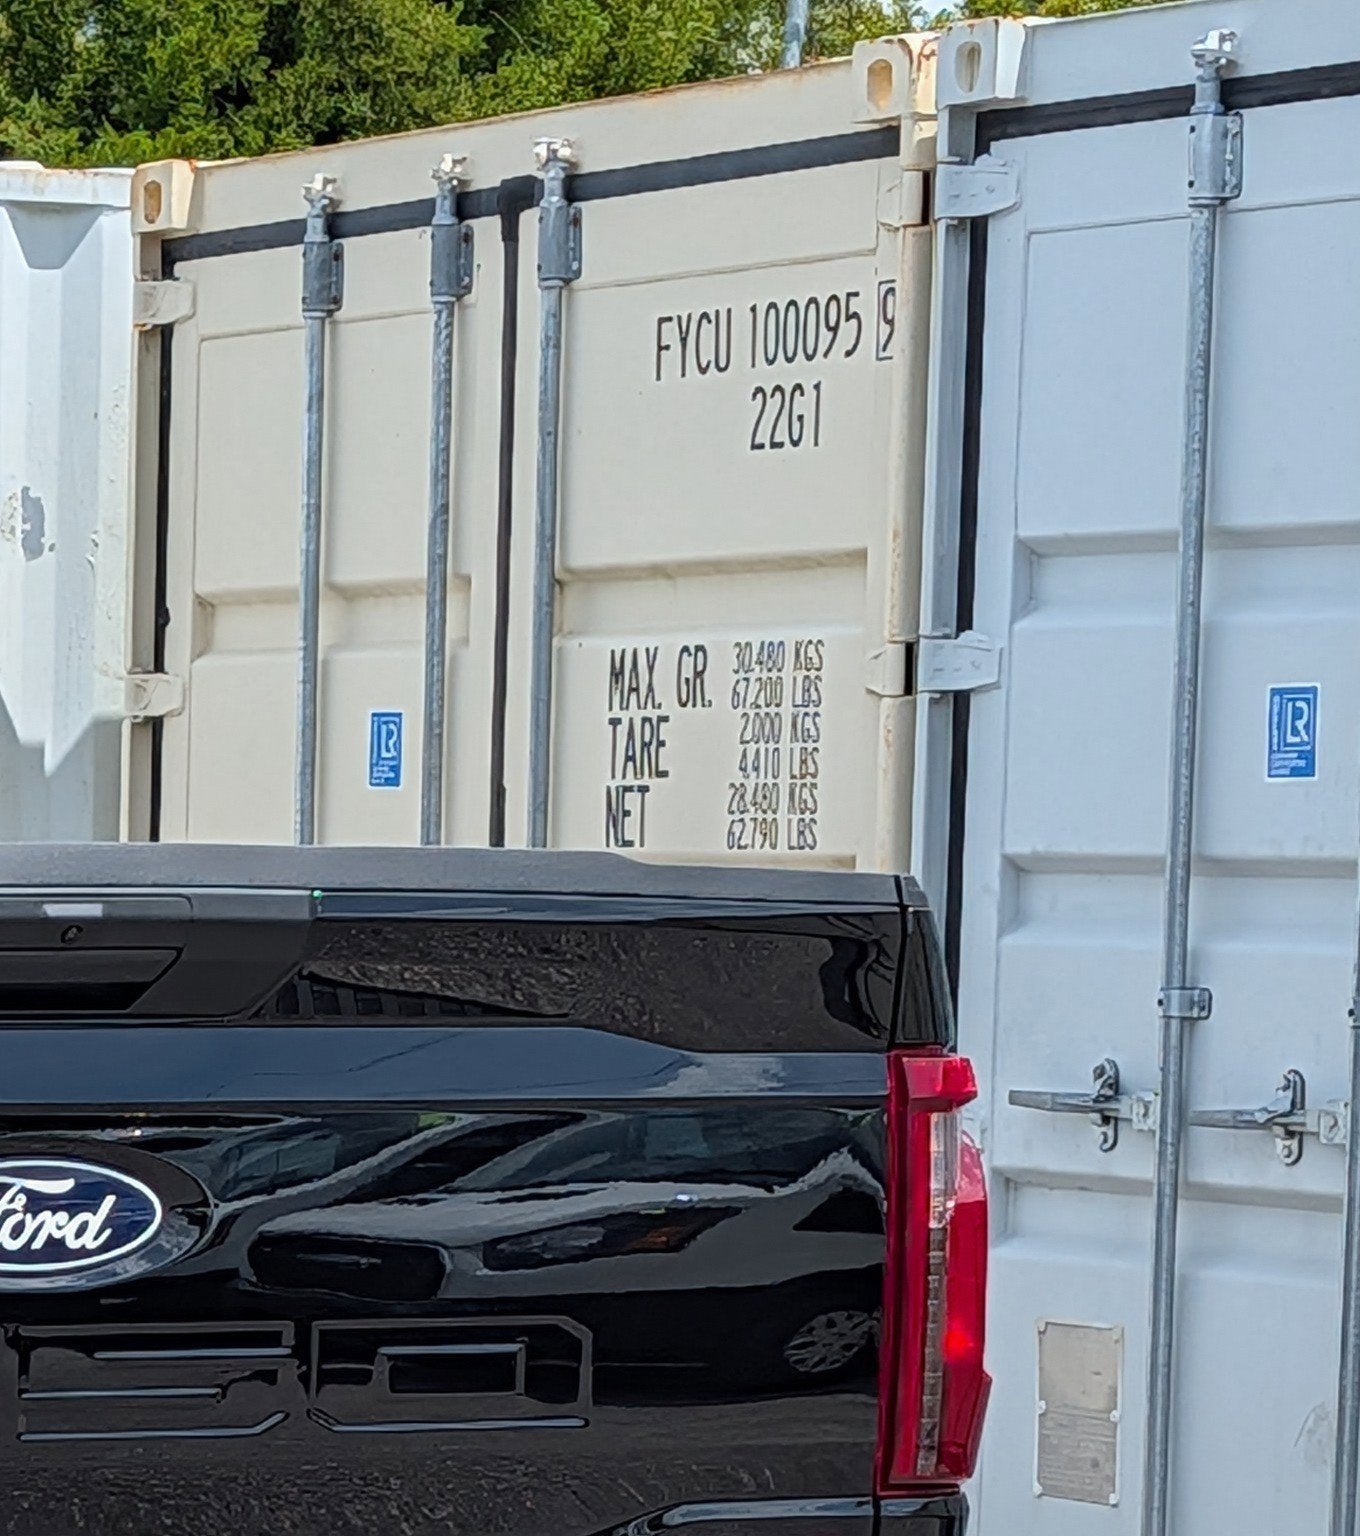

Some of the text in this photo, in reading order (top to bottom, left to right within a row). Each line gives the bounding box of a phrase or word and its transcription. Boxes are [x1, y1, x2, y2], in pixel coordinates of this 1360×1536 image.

[655, 307, 732, 381] FYCU
[749, 291, 863, 369] 100095
[750, 380, 822, 451] 22G1
[608, 646, 663, 711] MAX.
[676, 644, 712, 708] GR.
[793, 639, 826, 672] KGS
[791, 675, 823, 709] LBS
[608, 715, 670, 780] TARE
[789, 711, 822, 744] KGS
[789, 746, 820, 780] LBS
[605, 784, 650, 849] NET
[786, 782, 819, 816] KGS
[786, 816, 818, 851] LBS
